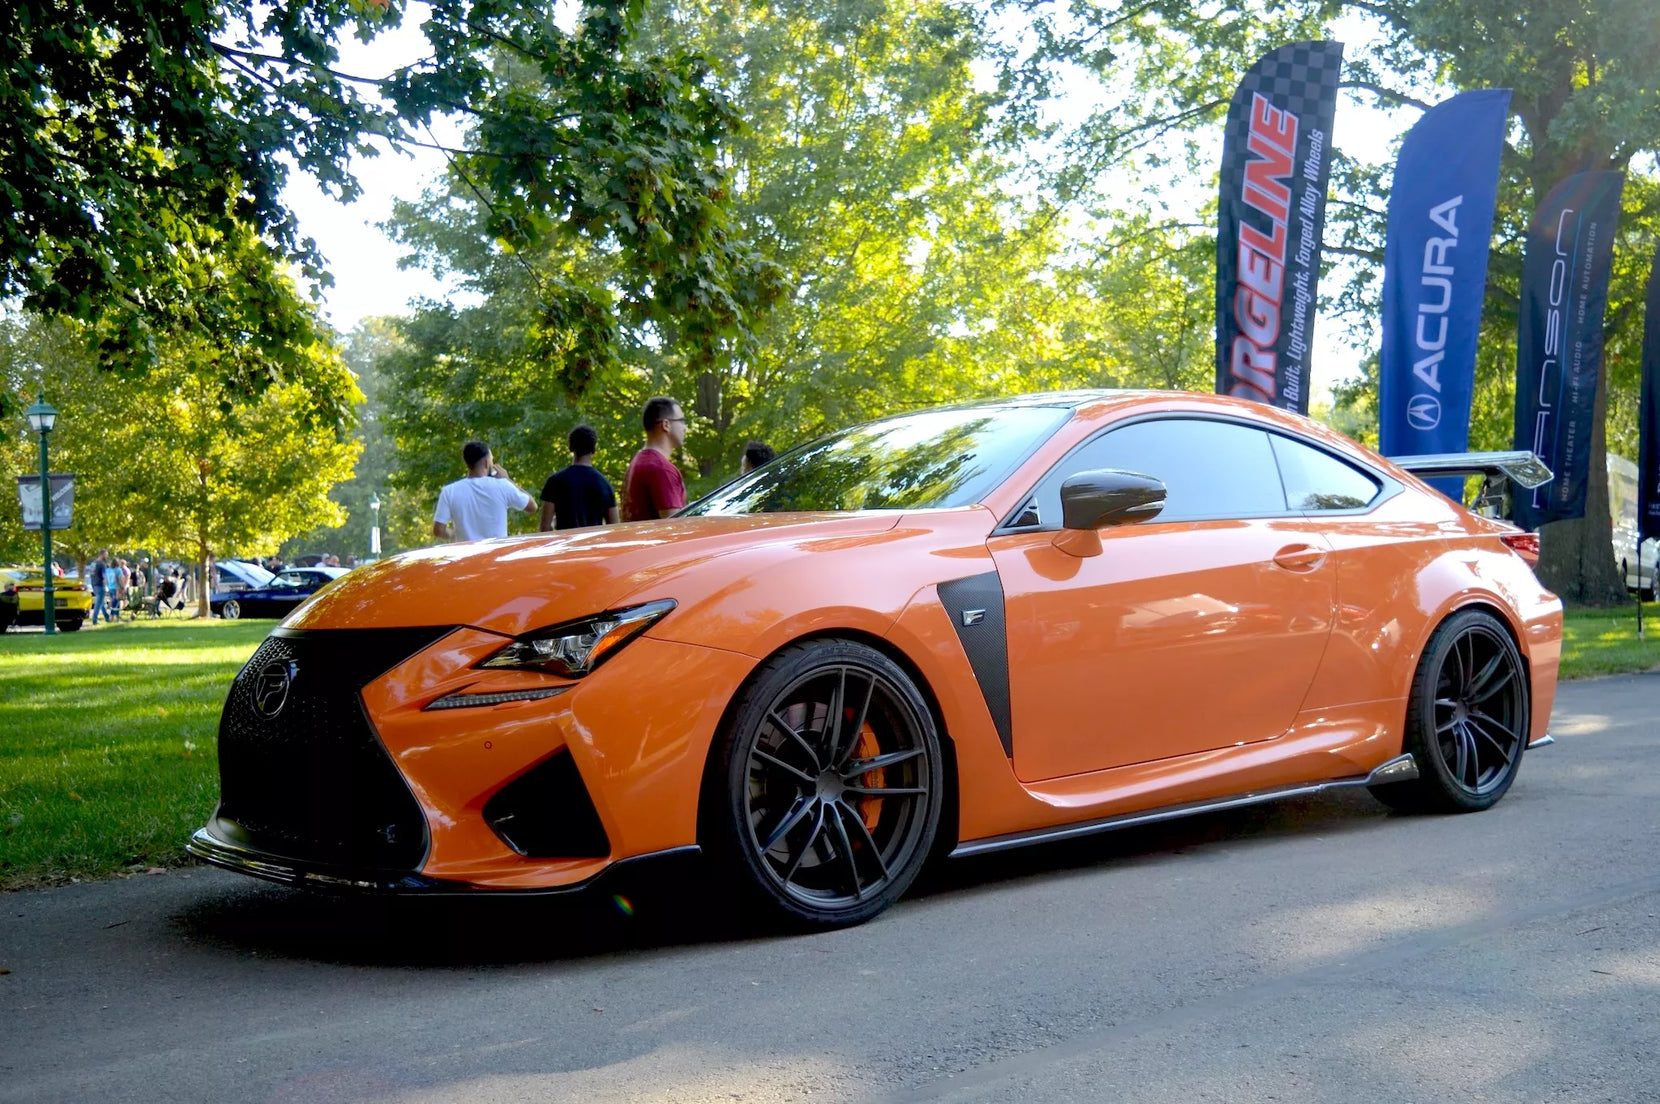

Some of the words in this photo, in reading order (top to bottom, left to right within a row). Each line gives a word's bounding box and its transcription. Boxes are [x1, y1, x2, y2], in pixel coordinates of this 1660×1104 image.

[1303, 128, 1324, 183] Wheels
[1299, 182, 1321, 219] Alloy
[1294, 216, 1316, 267] Forged
[1582, 222, 1597, 290] AUTOMATION
[1286, 271, 1312, 361] Lightweight,
[1412, 195, 1463, 393] ACURA
[1578, 294, 1588, 323] HOME
[1573, 340, 1583, 373] AUDIO
[1283, 365, 1302, 401] Built,
[1565, 420, 1576, 466] THEATER
[1561, 471, 1571, 501] HOME
